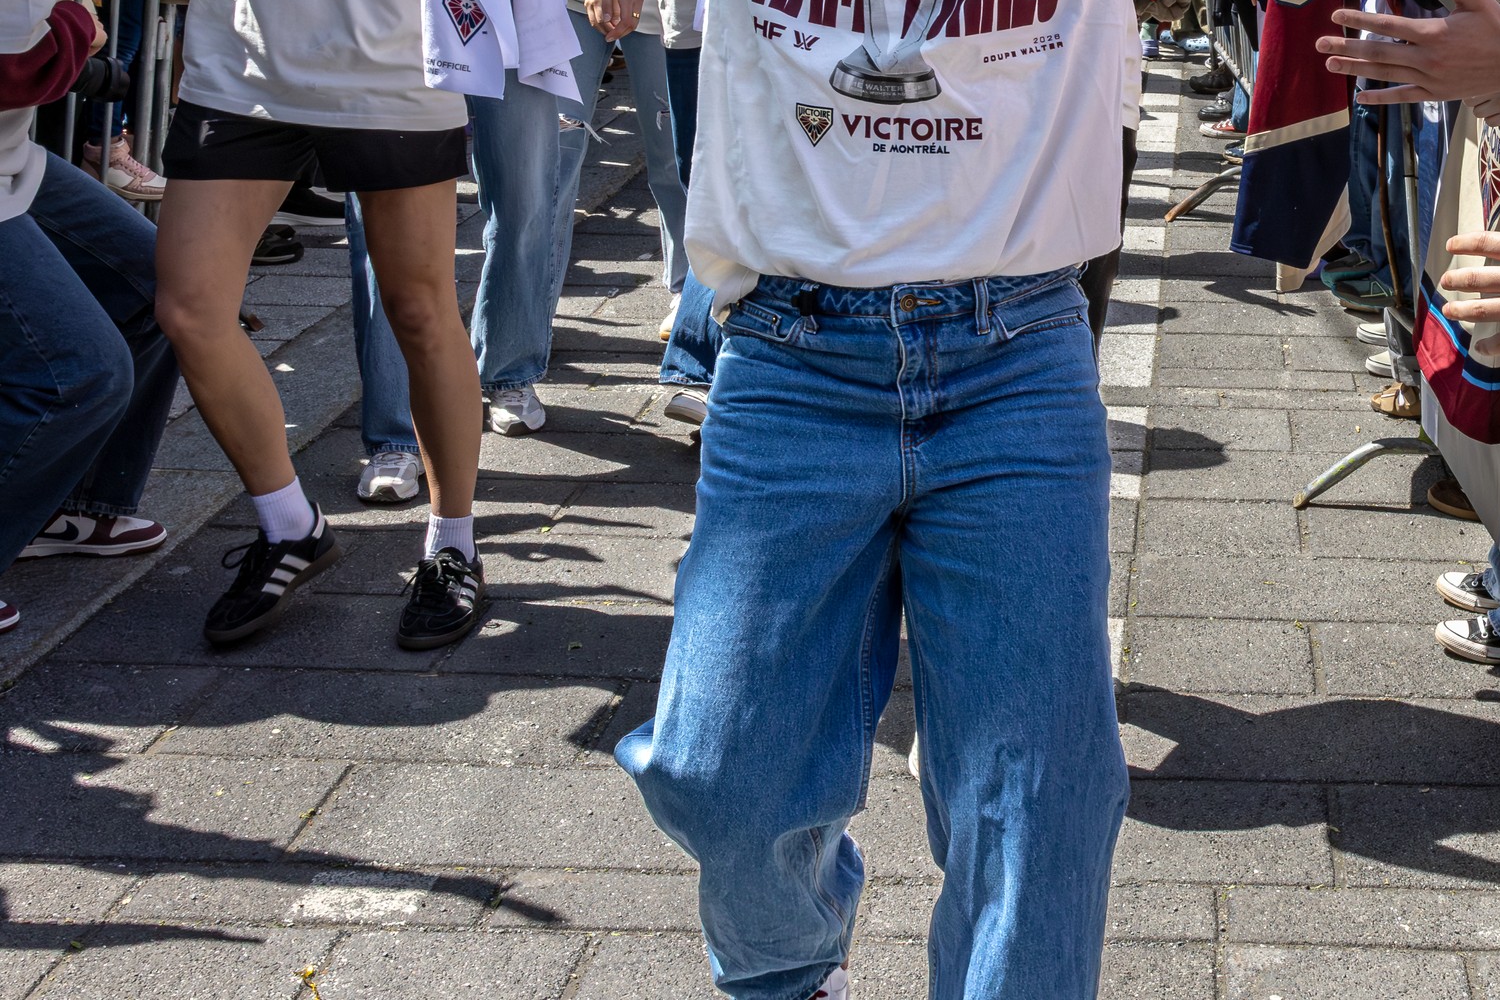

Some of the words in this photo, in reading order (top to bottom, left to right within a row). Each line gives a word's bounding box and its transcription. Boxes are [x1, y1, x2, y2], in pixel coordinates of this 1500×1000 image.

[752, 15, 787, 41] HF
[983, 48, 1018, 63] COUPE
[1020, 41, 1064, 57] WALTER
[436, 60, 472, 73] OFFICIEL
[842, 114, 983, 141] VICTOIRE
[873, 143, 887, 153] DE
[890, 142, 950, 154] MONTRÉAL
